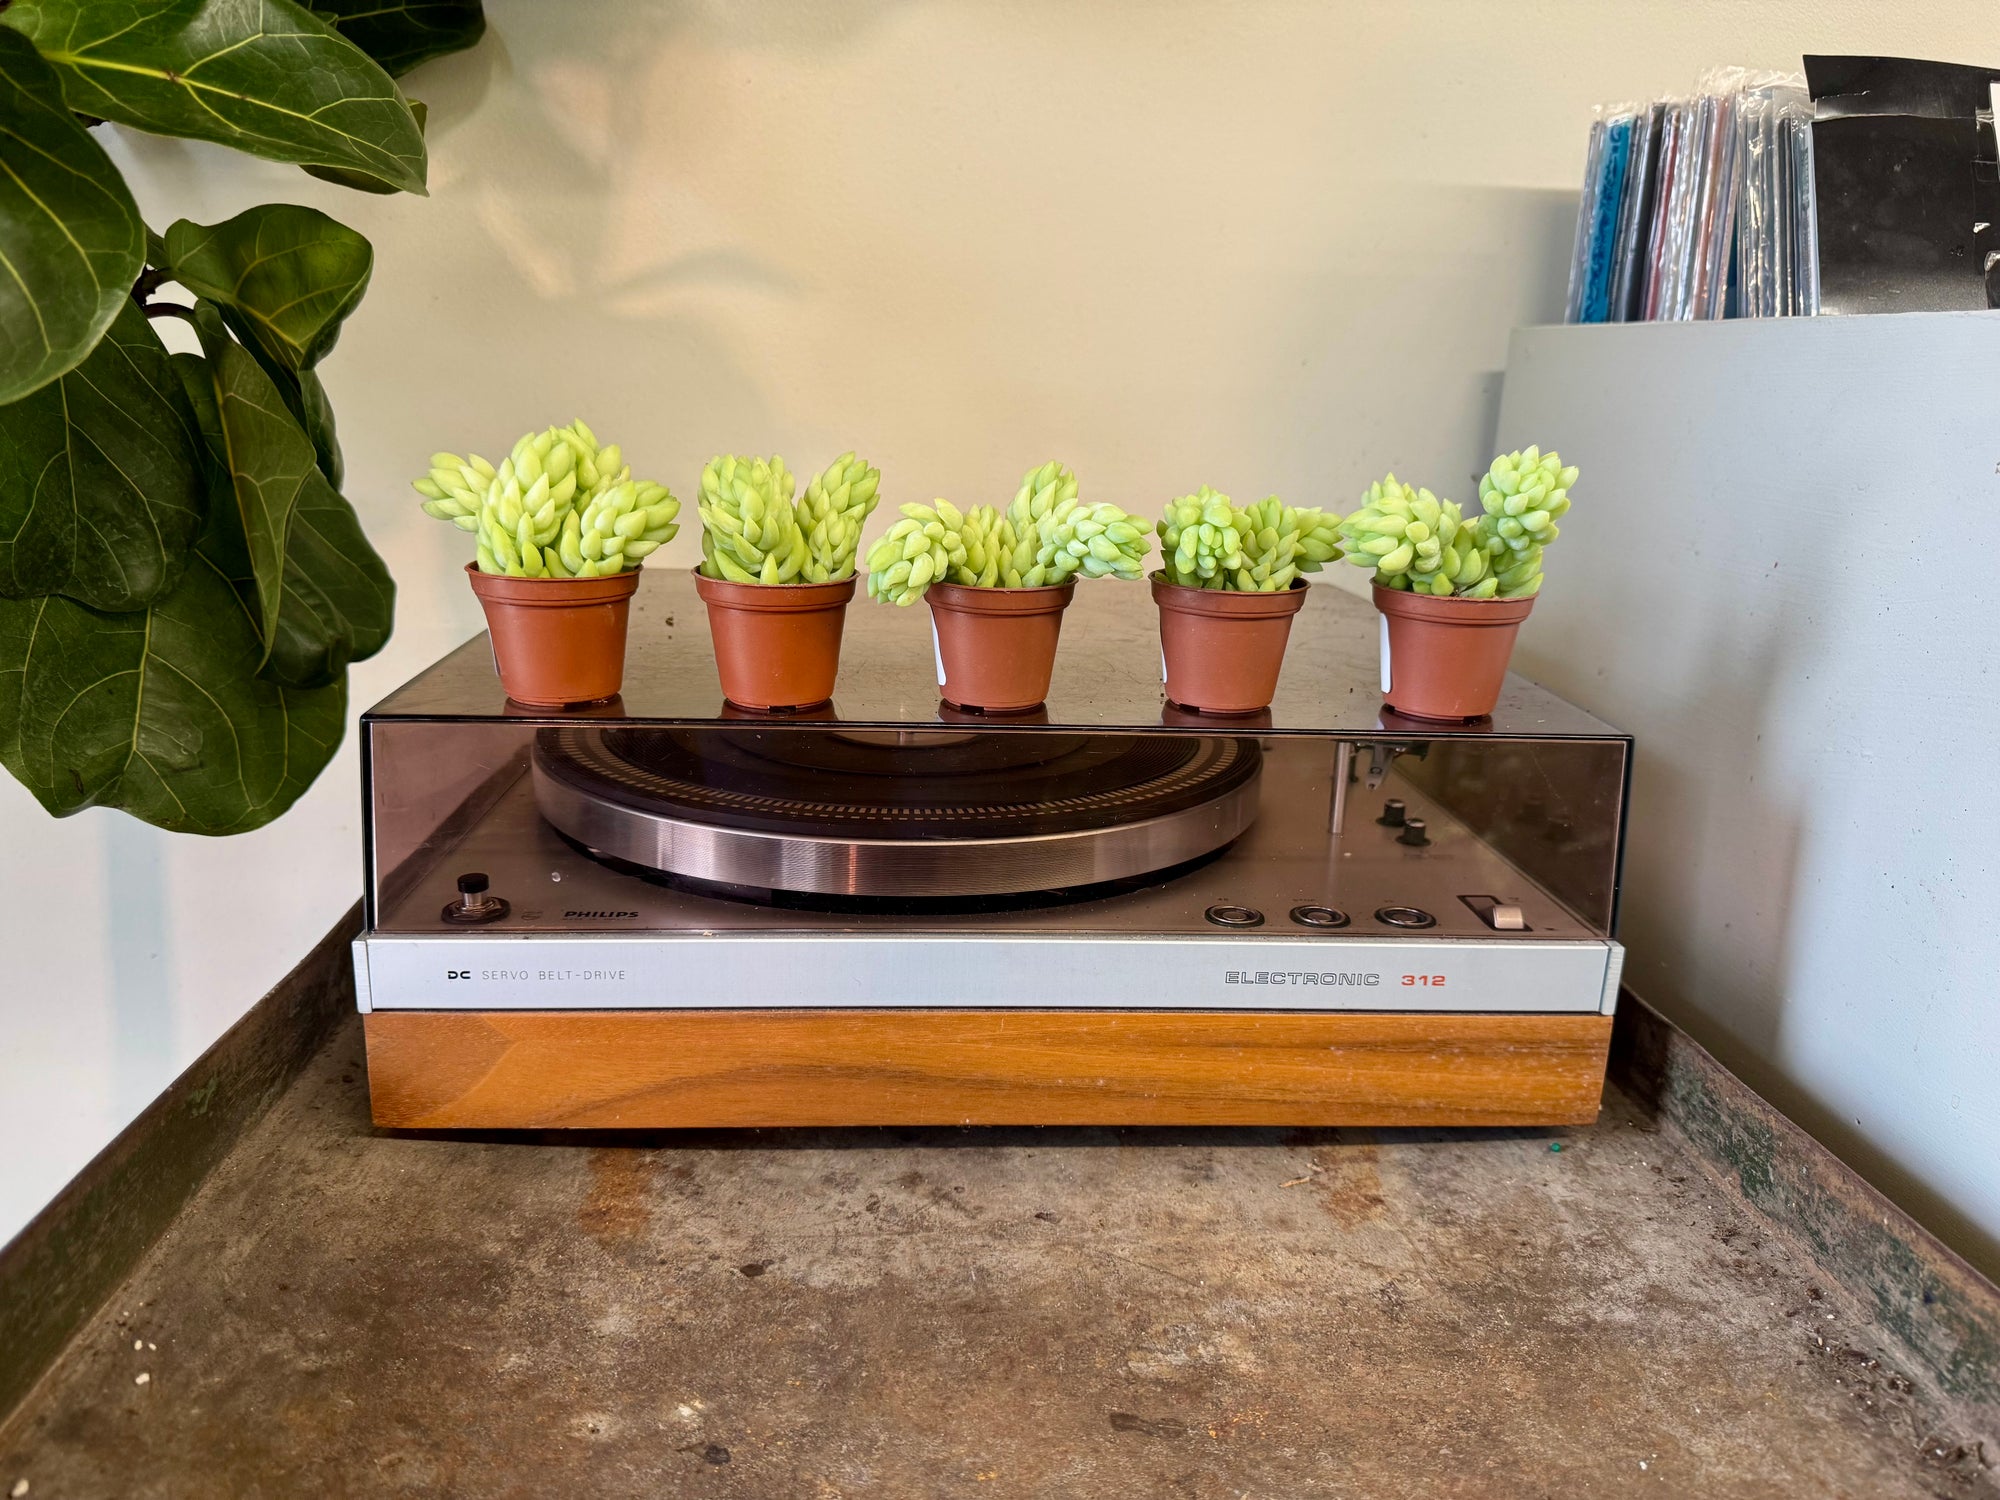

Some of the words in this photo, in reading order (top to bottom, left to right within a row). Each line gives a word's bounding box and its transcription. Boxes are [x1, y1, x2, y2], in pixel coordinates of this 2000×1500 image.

[447, 970, 471, 980] DC
[482, 970, 529, 980] SERVO
[539, 970, 626, 980] BELT-DRIVE
[1225, 971, 1380, 986] ELECTRONIC
[1401, 975, 1446, 986] 312
